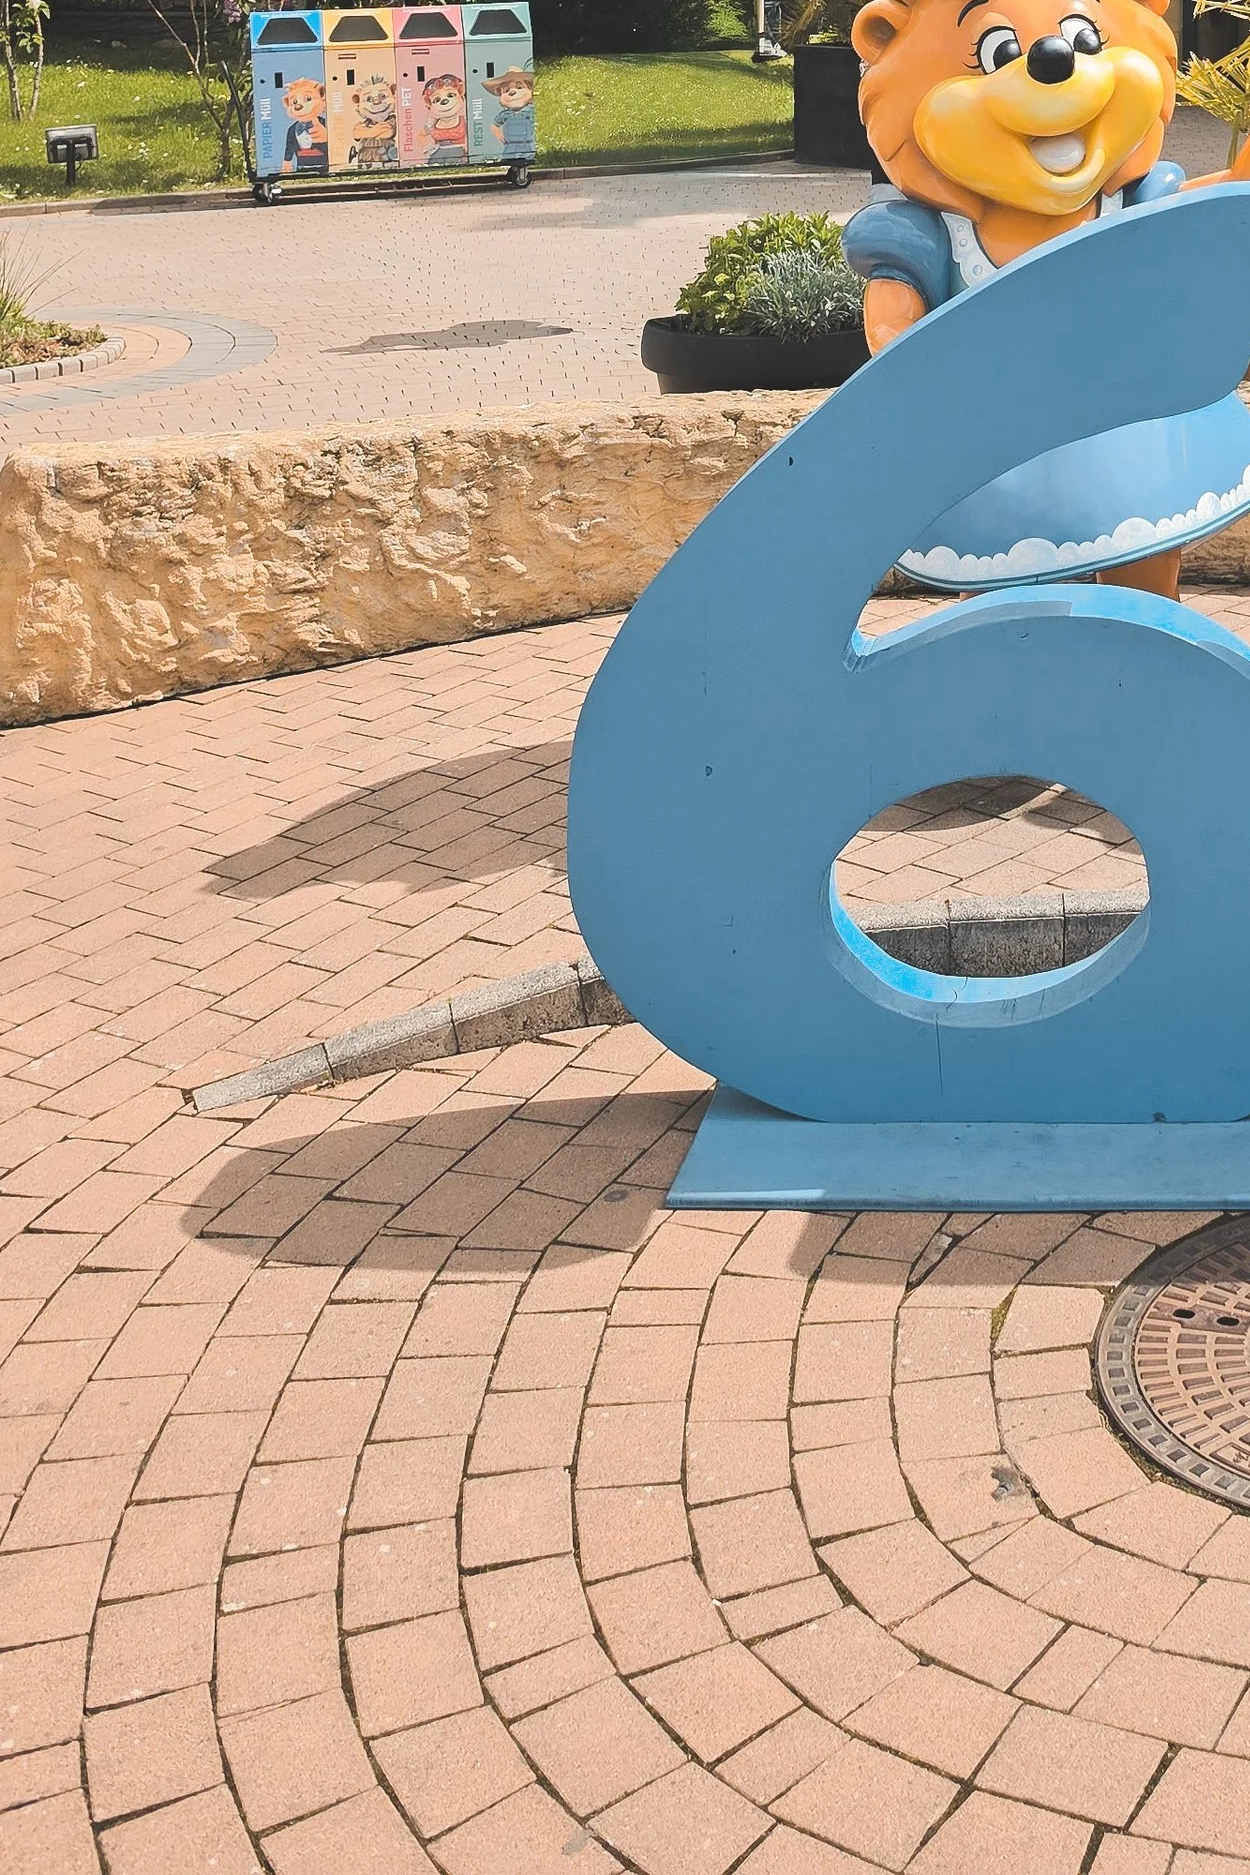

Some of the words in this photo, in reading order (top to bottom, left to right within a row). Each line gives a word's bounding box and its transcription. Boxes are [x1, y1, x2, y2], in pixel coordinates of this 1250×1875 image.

[401, 87, 412, 107] PET
[403, 108, 414, 152] Flaschen
[473, 121, 484, 146] REST
